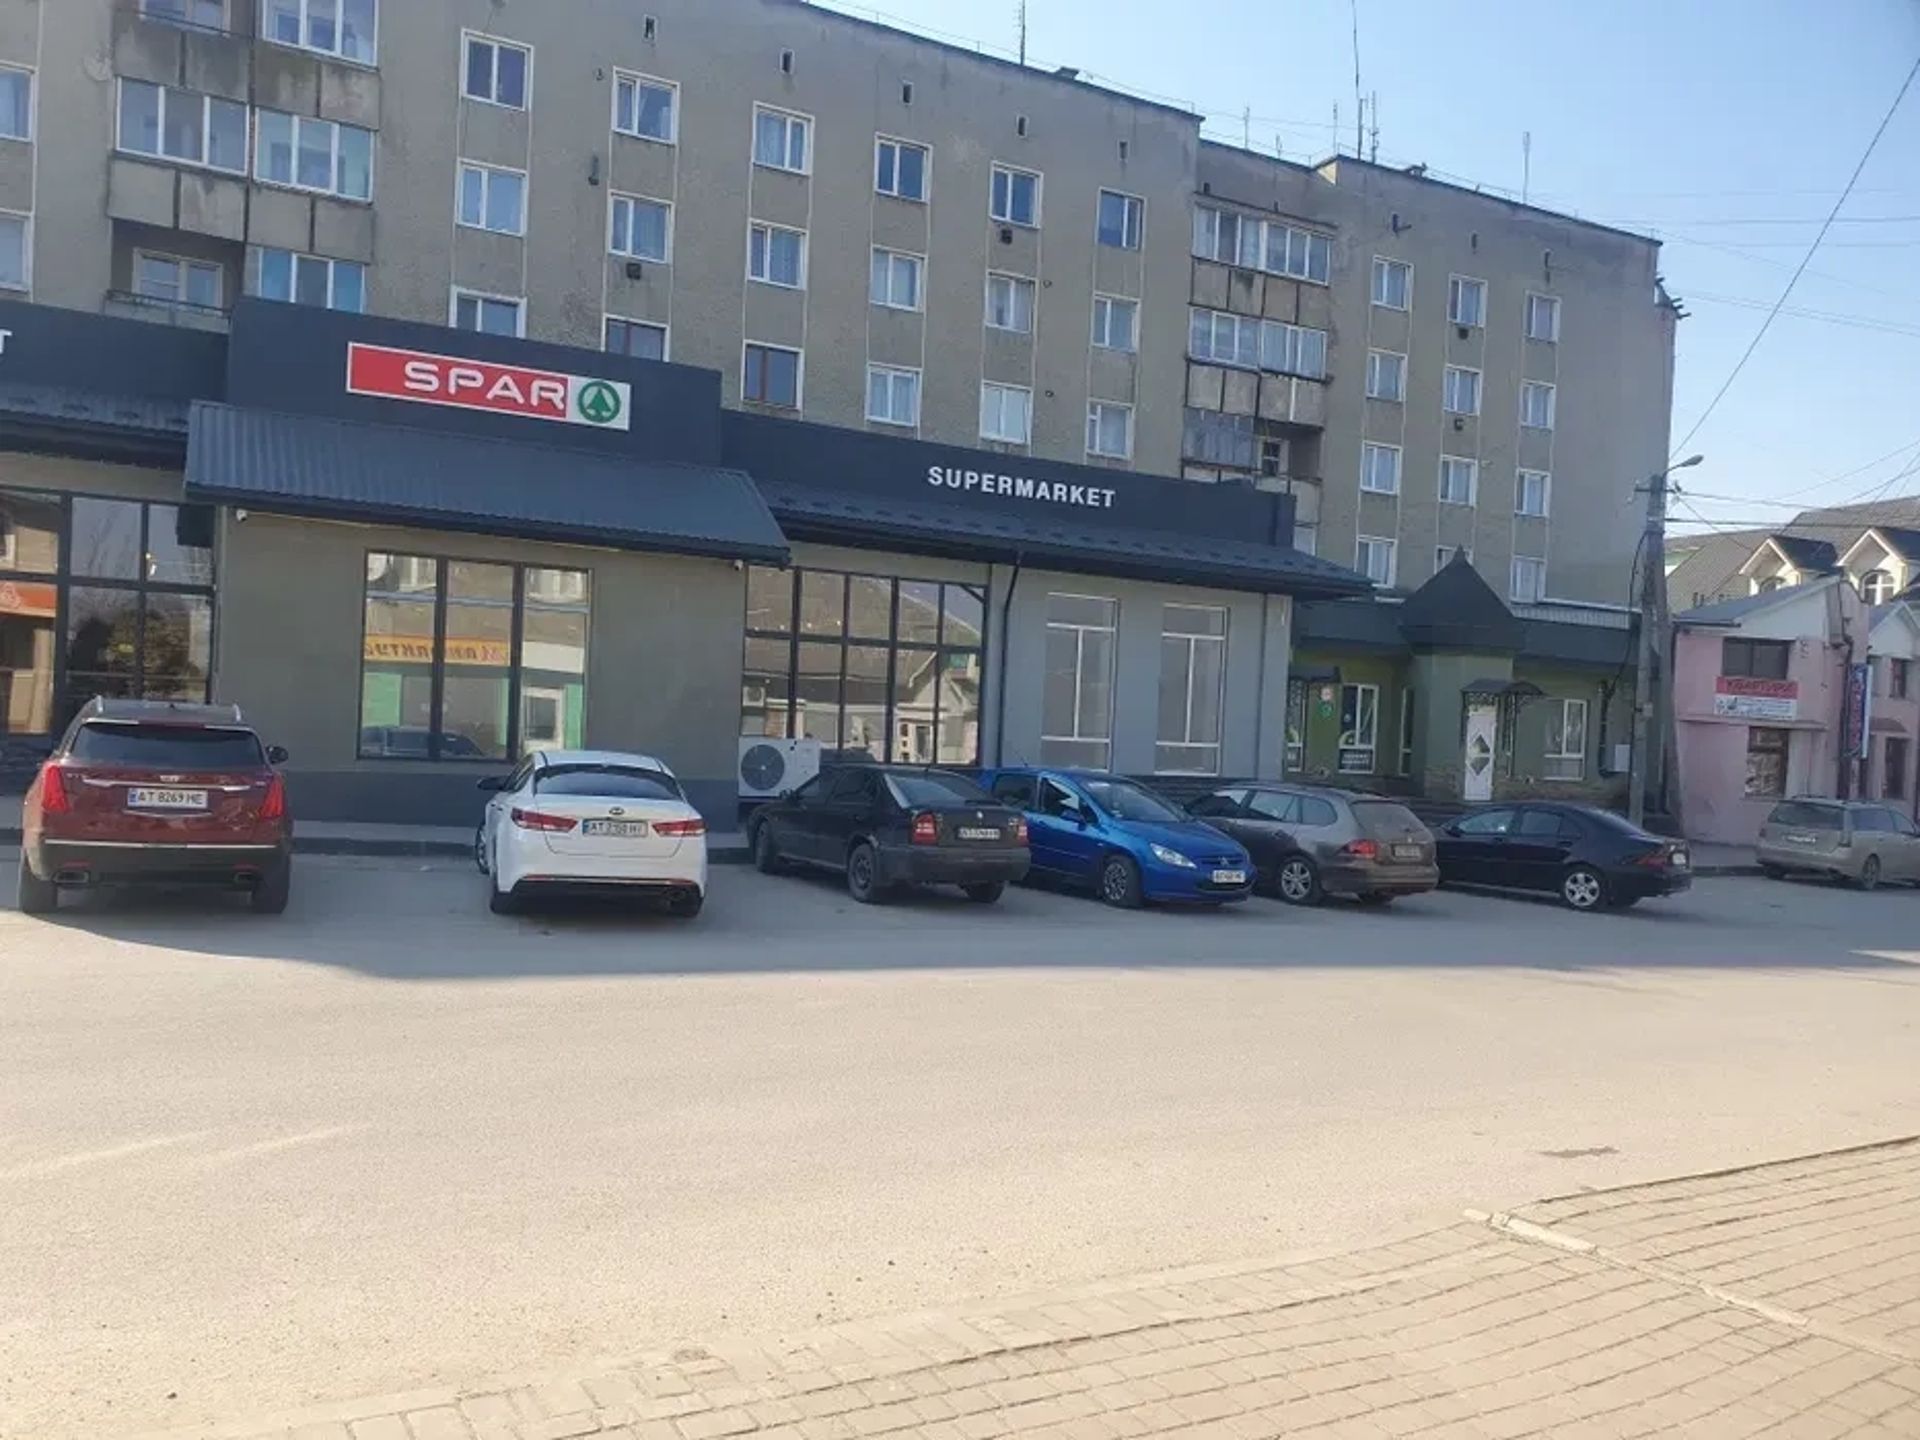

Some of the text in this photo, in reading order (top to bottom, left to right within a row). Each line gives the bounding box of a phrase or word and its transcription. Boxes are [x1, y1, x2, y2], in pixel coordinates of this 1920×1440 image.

[404, 361, 566, 410] SPAR
[928, 466, 1116, 507] SUPERMARKET
[139, 791, 203, 804] AT 8269 HE
